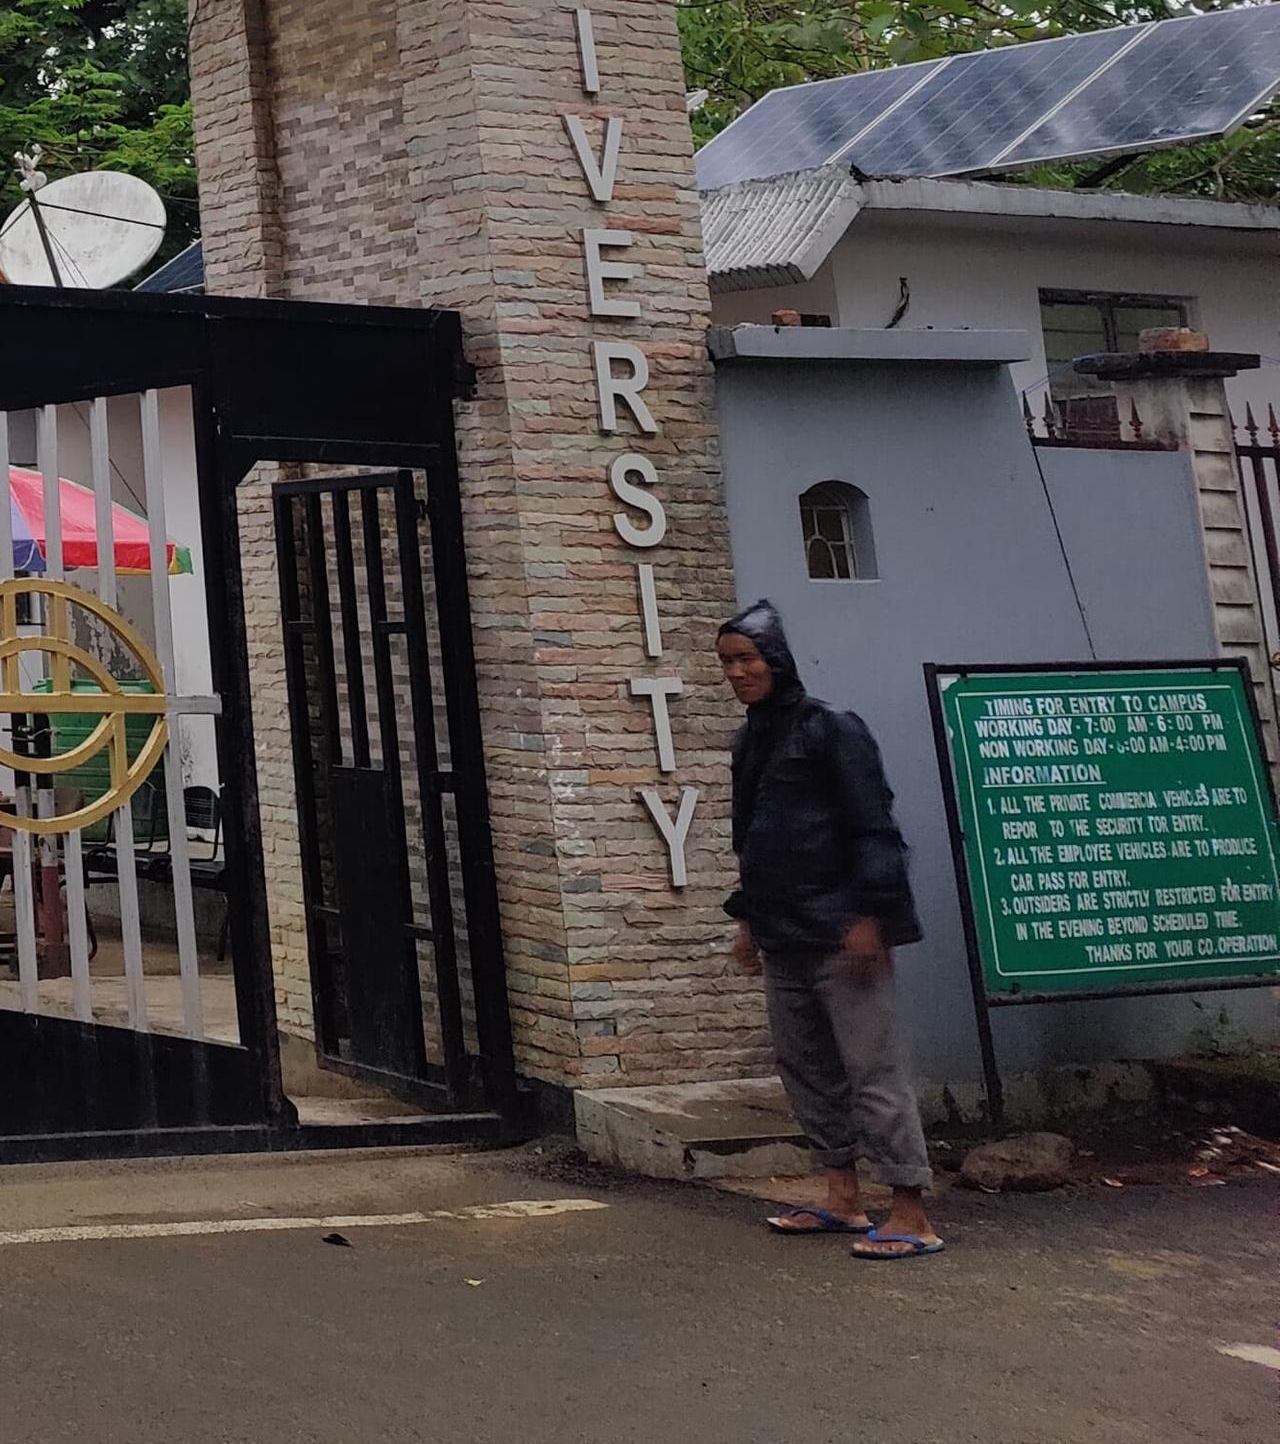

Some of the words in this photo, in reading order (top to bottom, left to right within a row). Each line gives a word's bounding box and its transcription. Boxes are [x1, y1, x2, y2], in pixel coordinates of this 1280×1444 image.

[985, 698, 1033, 716] TIMING
[1036, 697, 1065, 714] FOR
[1069, 696, 1115, 714] ENTRY
[1121, 695, 1142, 712] TO
[1148, 693, 1207, 711] CAMPUS
[974, 719, 1044, 738] WORKING
[1047, 718, 1073, 735] DAY
[1084, 717, 1116, 735] 7:00
[1127, 715, 1148, 733] AM
[1202, 714, 1224, 731] PM
[979, 740, 1010, 758] NON
[1012, 738, 1078, 757] WORKING
[1206, 734, 1227, 751] PM
[984, 763, 1102, 785] INFORMATION
[1000, 796, 1021, 815] ALL
[1023, 795, 1046, 813] THE
[1049, 794, 1091, 812] PRIVATE
[1098, 791, 1159, 810] COMMERCIA
[1212, 787, 1232, 806] ARE
[1232, 787, 1248, 805] TO
[1049, 820, 1065, 838] TO
[1095, 816, 1143, 835] SECURITY
[994, 848, 1005, 866] 2.
[1008, 847, 1029, 865] ALL
[1030, 846, 1054, 864] THE
[1057, 843, 1113, 863] EMPLOYEE
[1116, 840, 1167, 861] VEHICLES
[1171, 840, 1192, 858] ARE
[1194, 839, 1210, 857] TO
[1211, 837, 1258, 856] PRODUCE
[1011, 873, 1034, 892] CAR
[1038, 872, 1066, 891] PASS
[1067, 871, 1089, 889] FOR
[1092, 869, 1131, 888] ENTRY.
[1001, 897, 1012, 916] 3.
[1013, 894, 1071, 915] OUTSIDERS
[1077, 892, 1099, 911] ARE
[1103, 889, 1150, 910] STRICTLY
[1155, 885, 1216, 906] RESTRICTED
[1220, 884, 1242, 902] FOR
[1242, 883, 1274, 902] ENTRY
[1015, 923, 1028, 941] IN
[1031, 921, 1054, 940] THE
[1058, 918, 1104, 939] EVENING
[1107, 916, 1148, 935] BEYOND
[1152, 912, 1209, 932] SCHEDULED
[1214, 910, 1242, 929] TIME.
[1085, 943, 1132, 963] THANKS
[1135, 942, 1158, 960] FOR
[1164, 939, 1193, 958] YOUR
